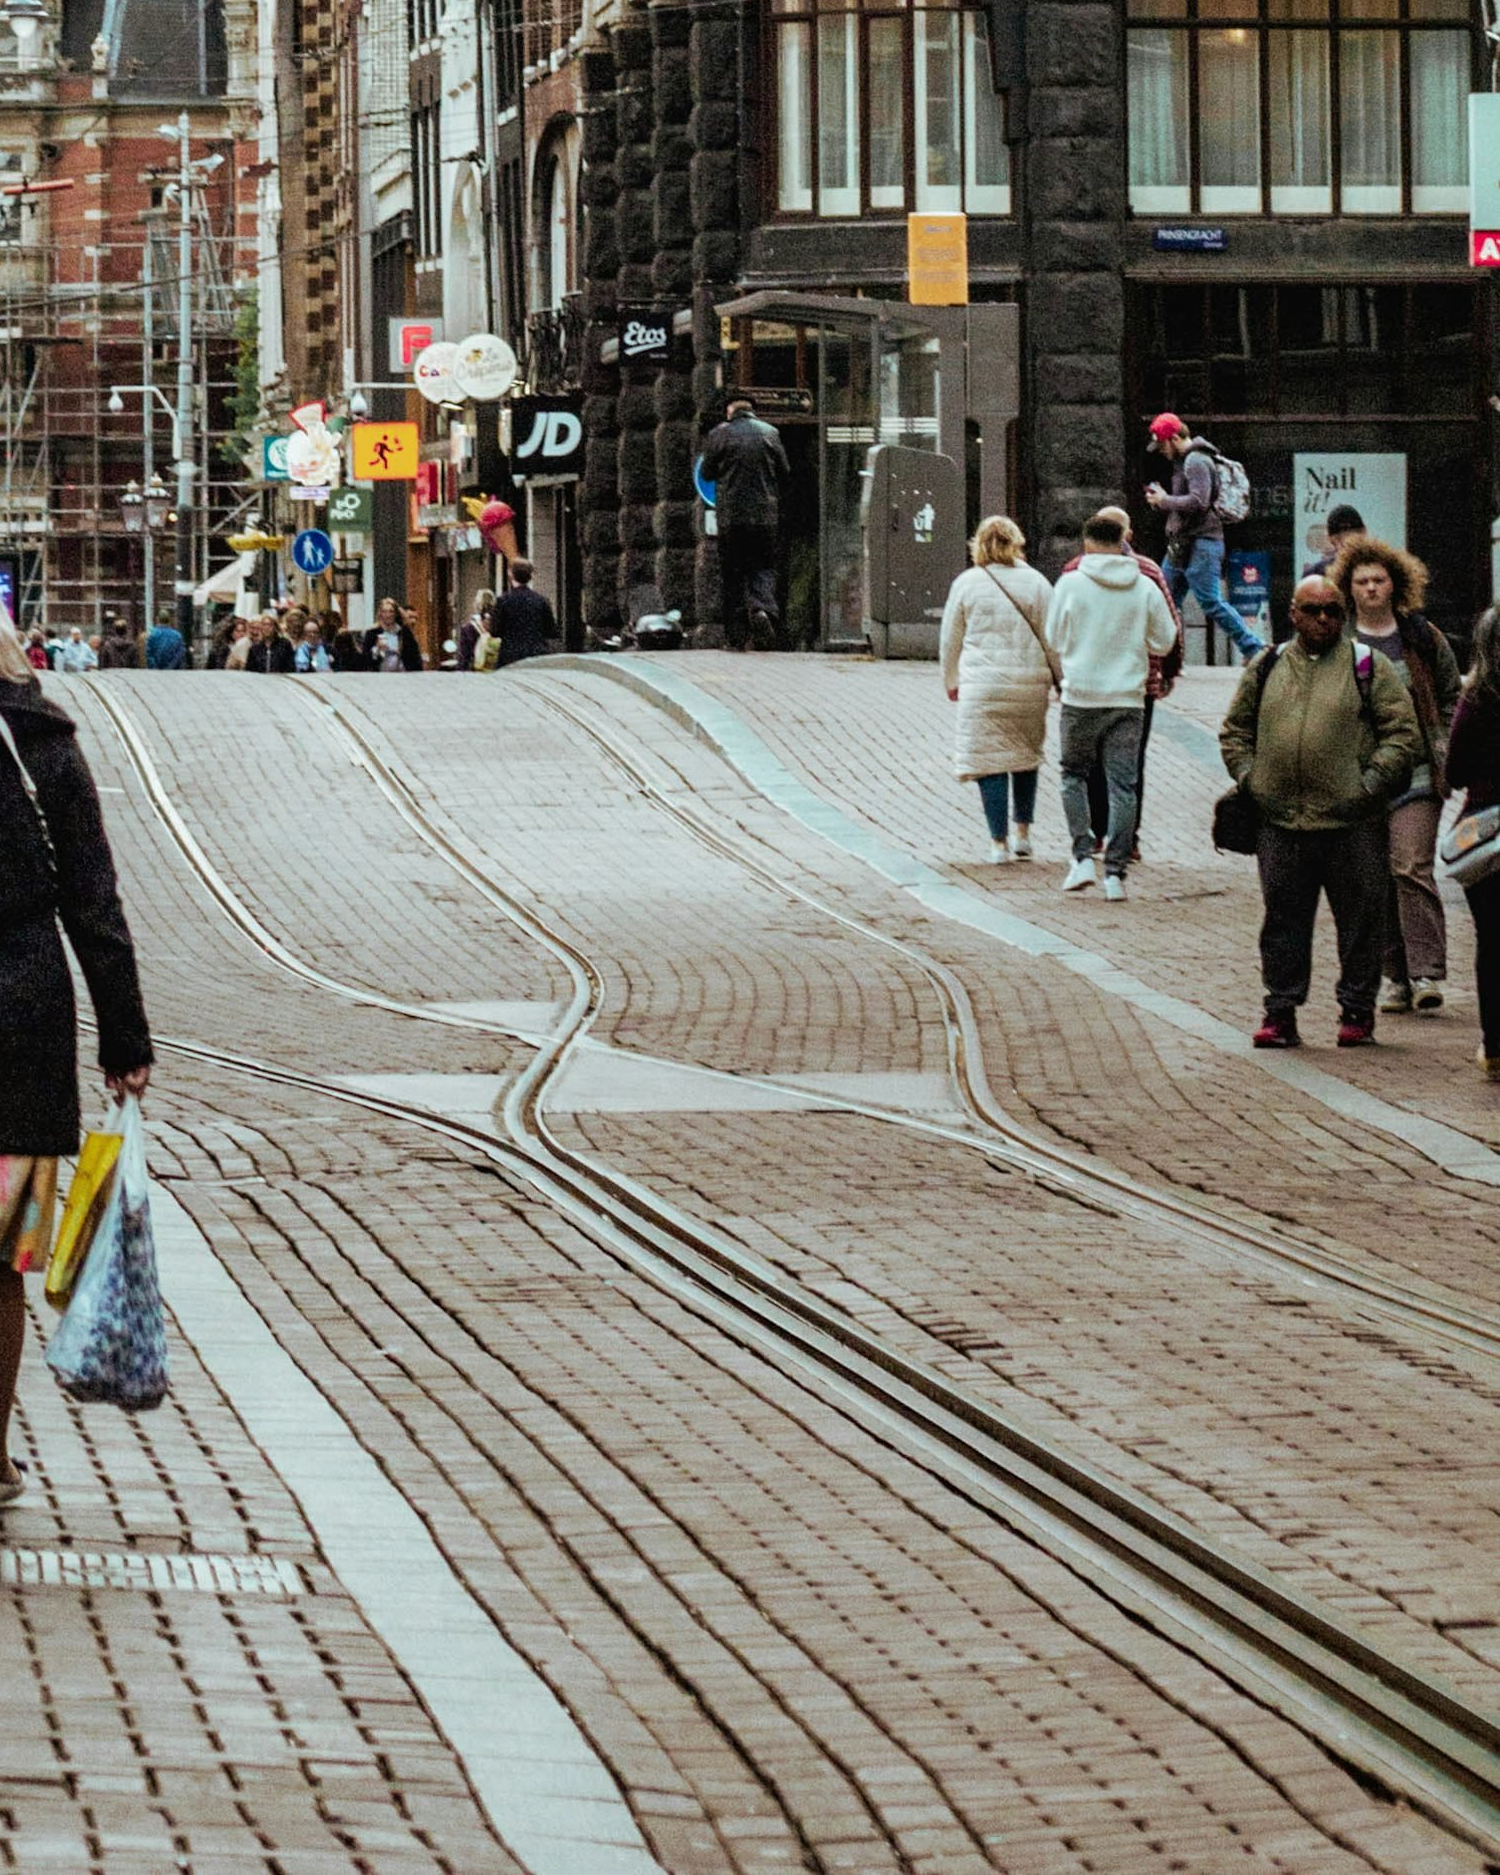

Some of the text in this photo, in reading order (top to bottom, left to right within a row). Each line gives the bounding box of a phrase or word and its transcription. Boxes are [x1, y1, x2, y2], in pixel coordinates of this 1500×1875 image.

[1479, 236, 1500, 261] A
[402, 325, 433, 365] F
[623, 320, 668, 348] Etos
[516, 411, 583, 459] JD
[1305, 467, 1357, 490] Nail
[1303, 491, 1331, 513] it!
